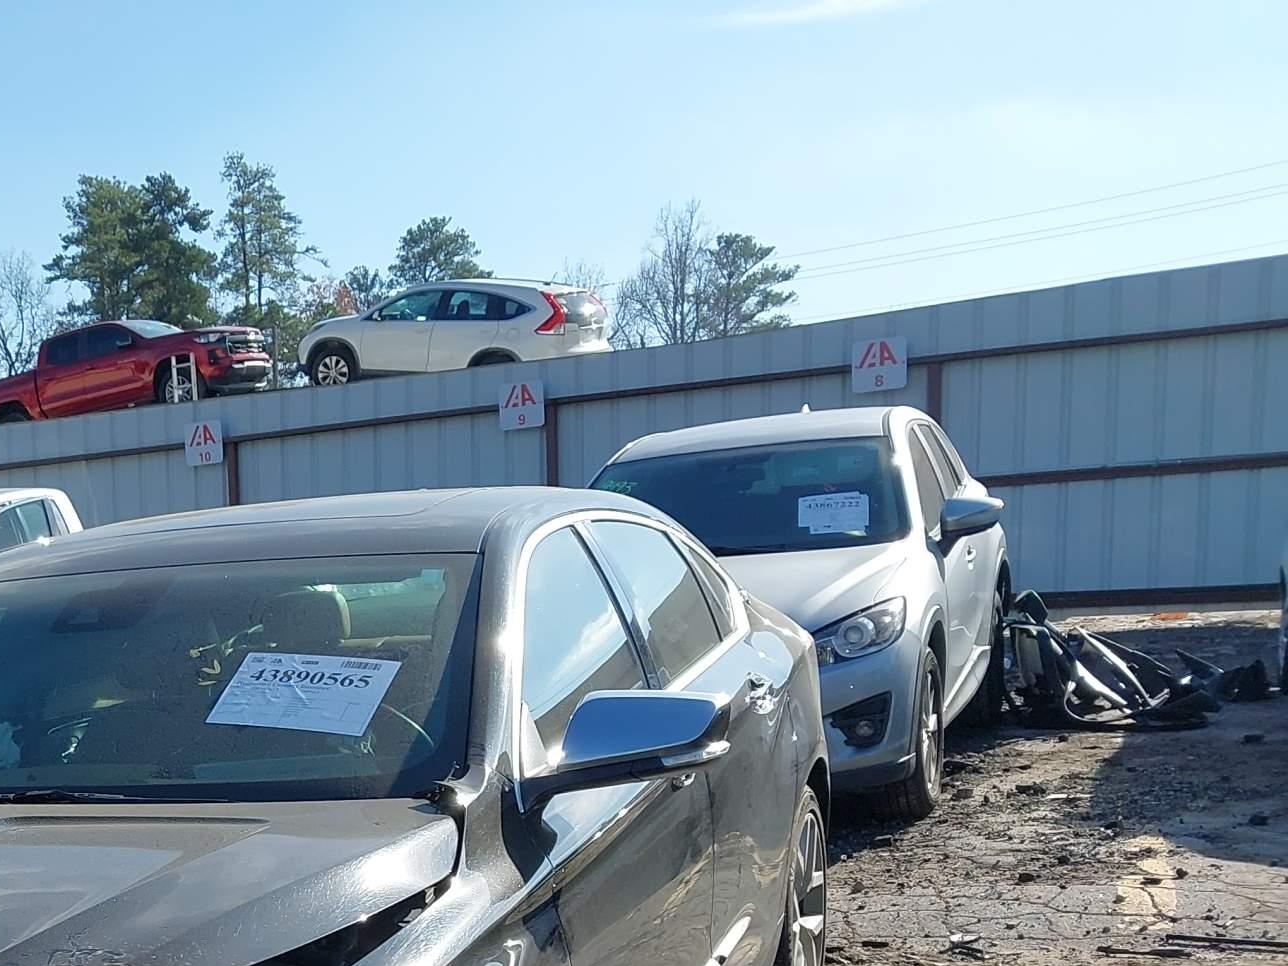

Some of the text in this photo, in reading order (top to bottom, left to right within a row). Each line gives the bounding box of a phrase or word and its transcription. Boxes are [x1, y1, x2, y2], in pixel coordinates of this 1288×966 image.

[875, 375, 884, 387] 8
[518, 414, 526, 425] 9
[199, 451, 211, 463] 10
[249, 668, 374, 689] 43890565
